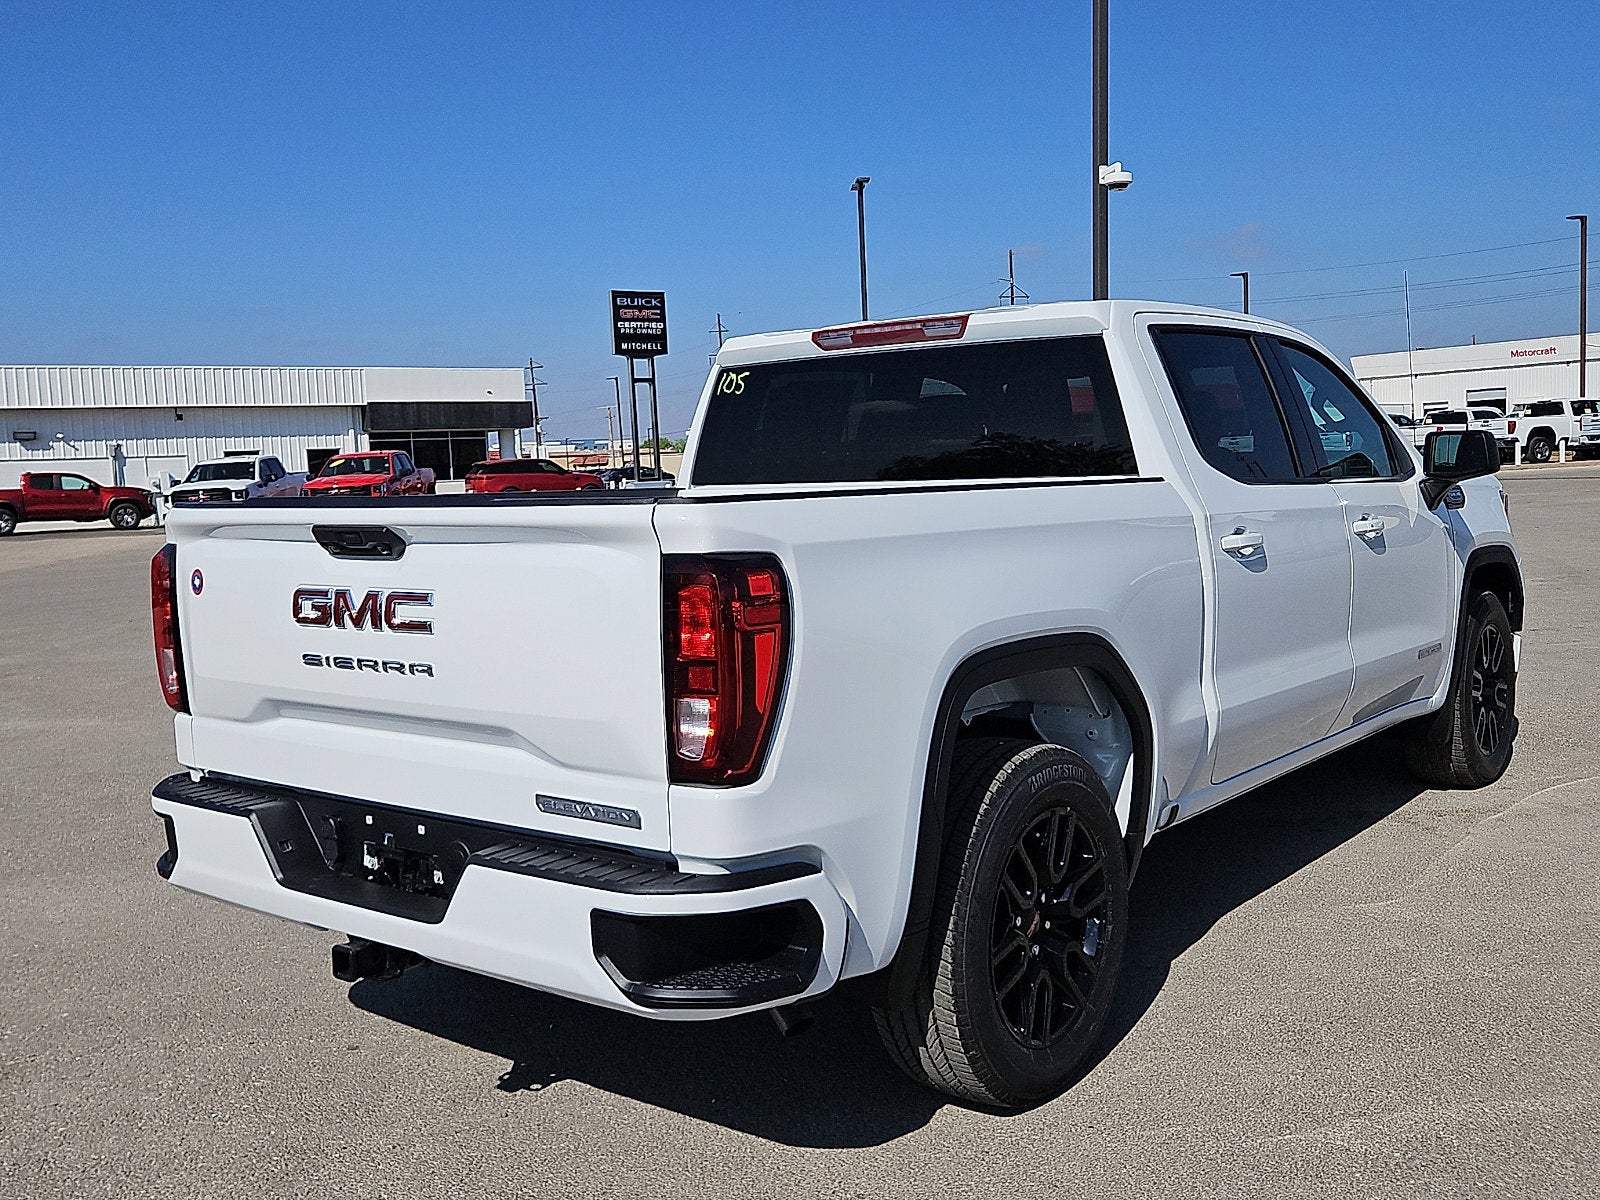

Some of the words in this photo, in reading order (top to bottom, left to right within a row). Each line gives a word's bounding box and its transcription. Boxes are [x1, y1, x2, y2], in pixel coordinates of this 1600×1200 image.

[616, 297, 662, 307] BUICK
[620, 308, 661, 319] GMC
[617, 321, 664, 329] CERTIFIED
[621, 342, 662, 350] MITCHELL
[1510, 346, 1557, 358] Motorcraft
[716, 371, 751, 396] 105
[292, 584, 436, 636] GMC
[301, 653, 435, 678] SIERRA
